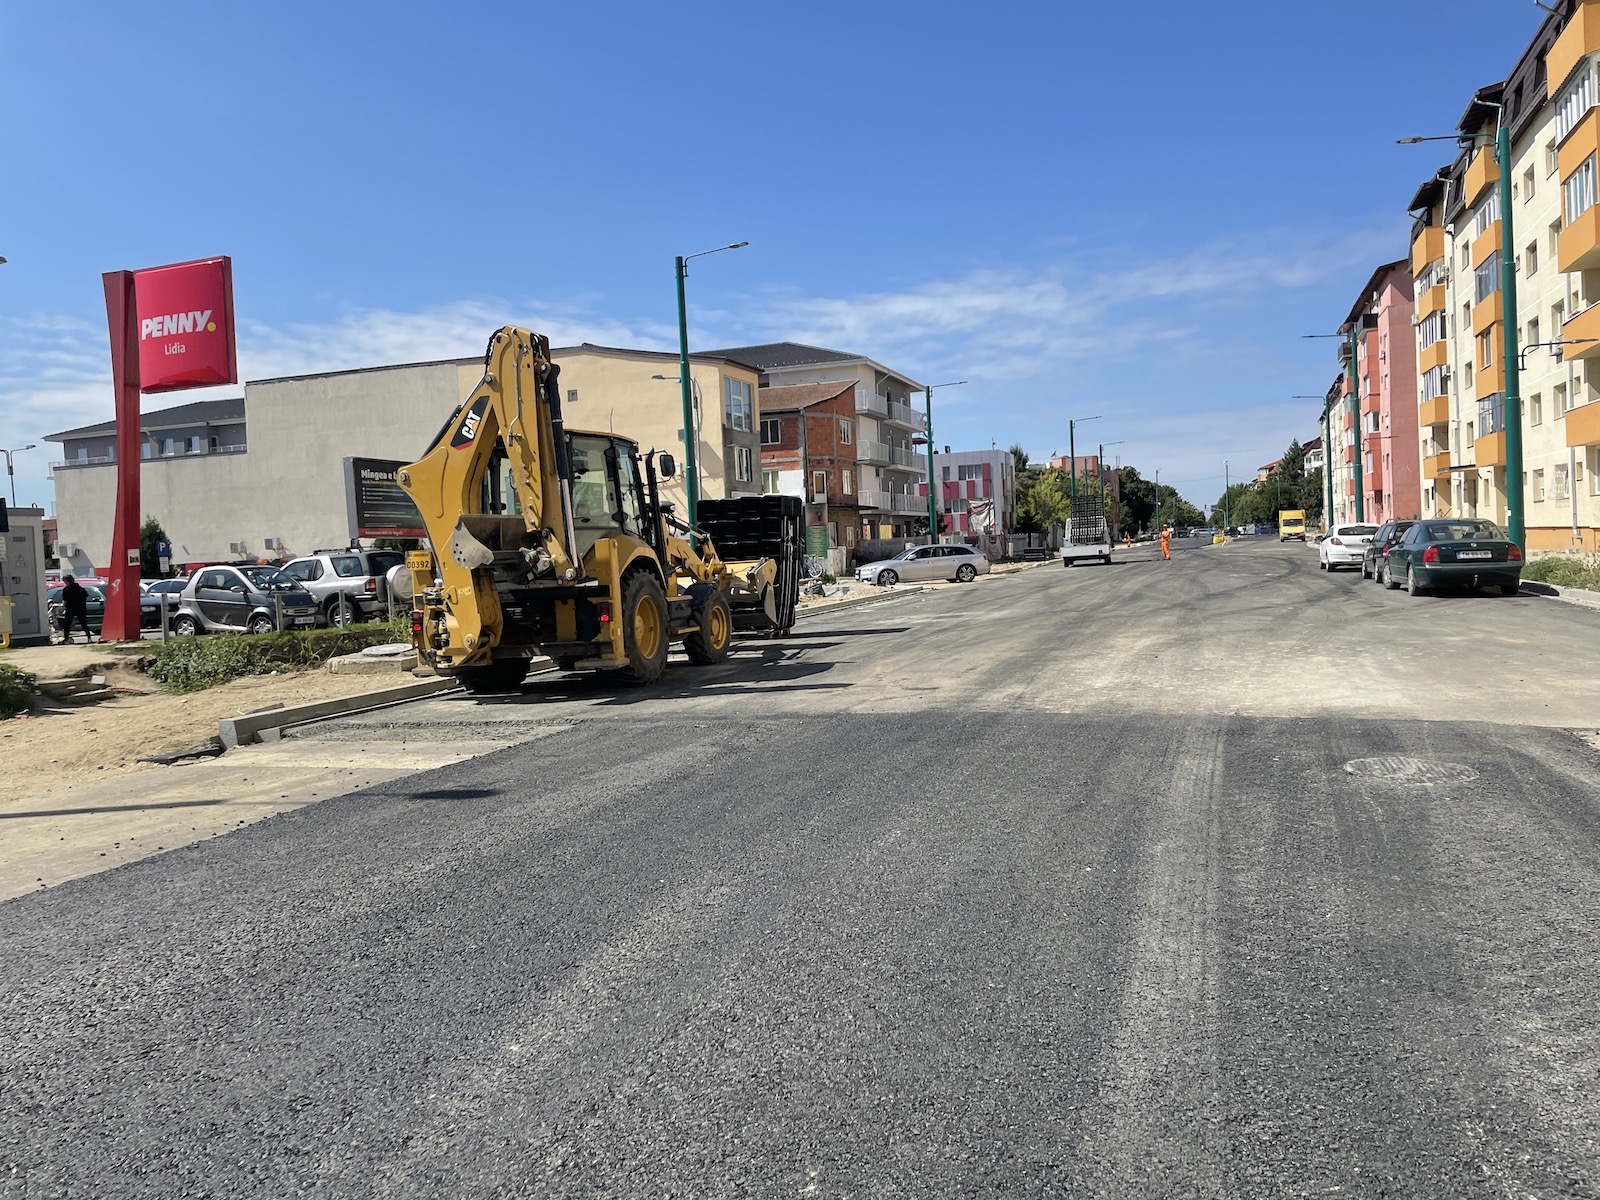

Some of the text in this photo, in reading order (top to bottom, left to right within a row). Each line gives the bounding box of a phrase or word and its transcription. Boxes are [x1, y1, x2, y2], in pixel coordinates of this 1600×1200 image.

[164, 342, 186, 356] Lidia
[461, 409, 481, 440] CAT
[360, 468, 388, 481] Mingea
[159, 541, 166, 552] P
[406, 560, 430, 569] 00392
